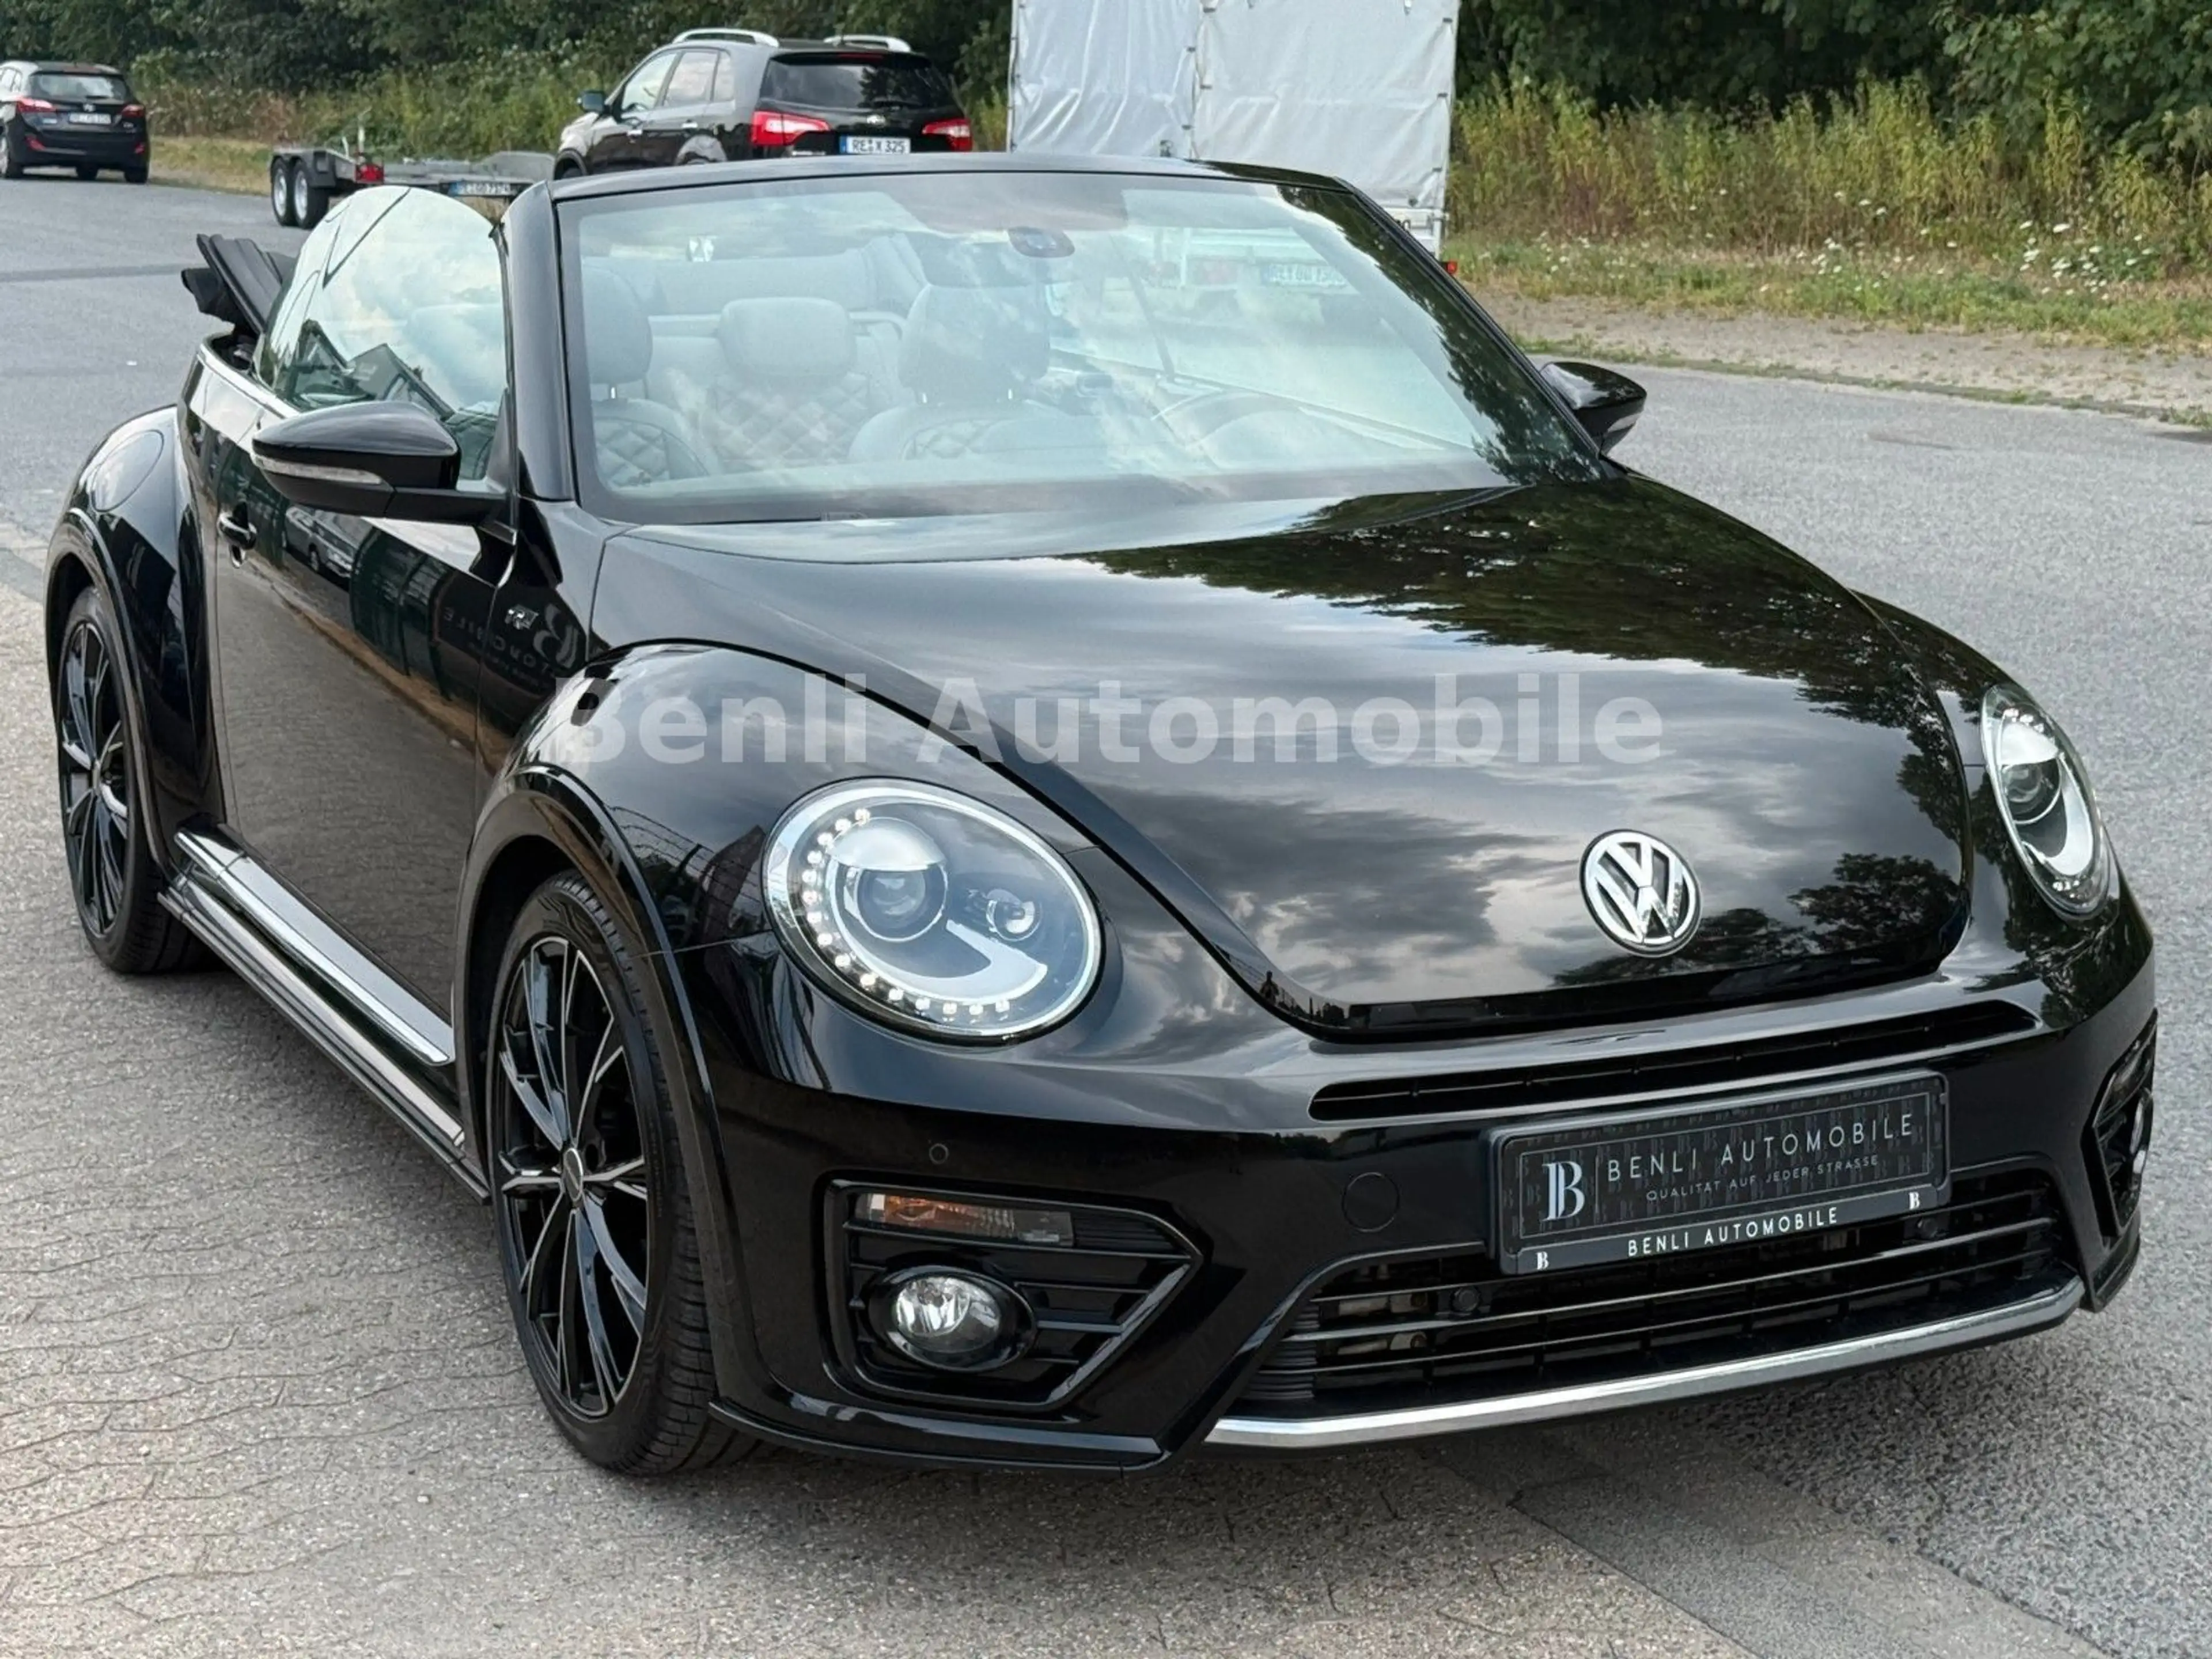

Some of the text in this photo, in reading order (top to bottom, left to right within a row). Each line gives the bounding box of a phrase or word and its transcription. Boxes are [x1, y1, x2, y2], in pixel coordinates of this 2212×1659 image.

[852, 139, 866, 152] RE
[885, 141, 906, 153] 325
[1608, 1114, 1912, 1181] BENLI AUTOMOBILE
[1542, 1160, 1585, 1222] B
[1729, 1175, 1757, 1192] AUF
[1765, 1166, 1809, 1184] JEDER
[1817, 1154, 1878, 1175] STRASSE
[1628, 1207, 1837, 1257] BENLI AUTOMOBILE
